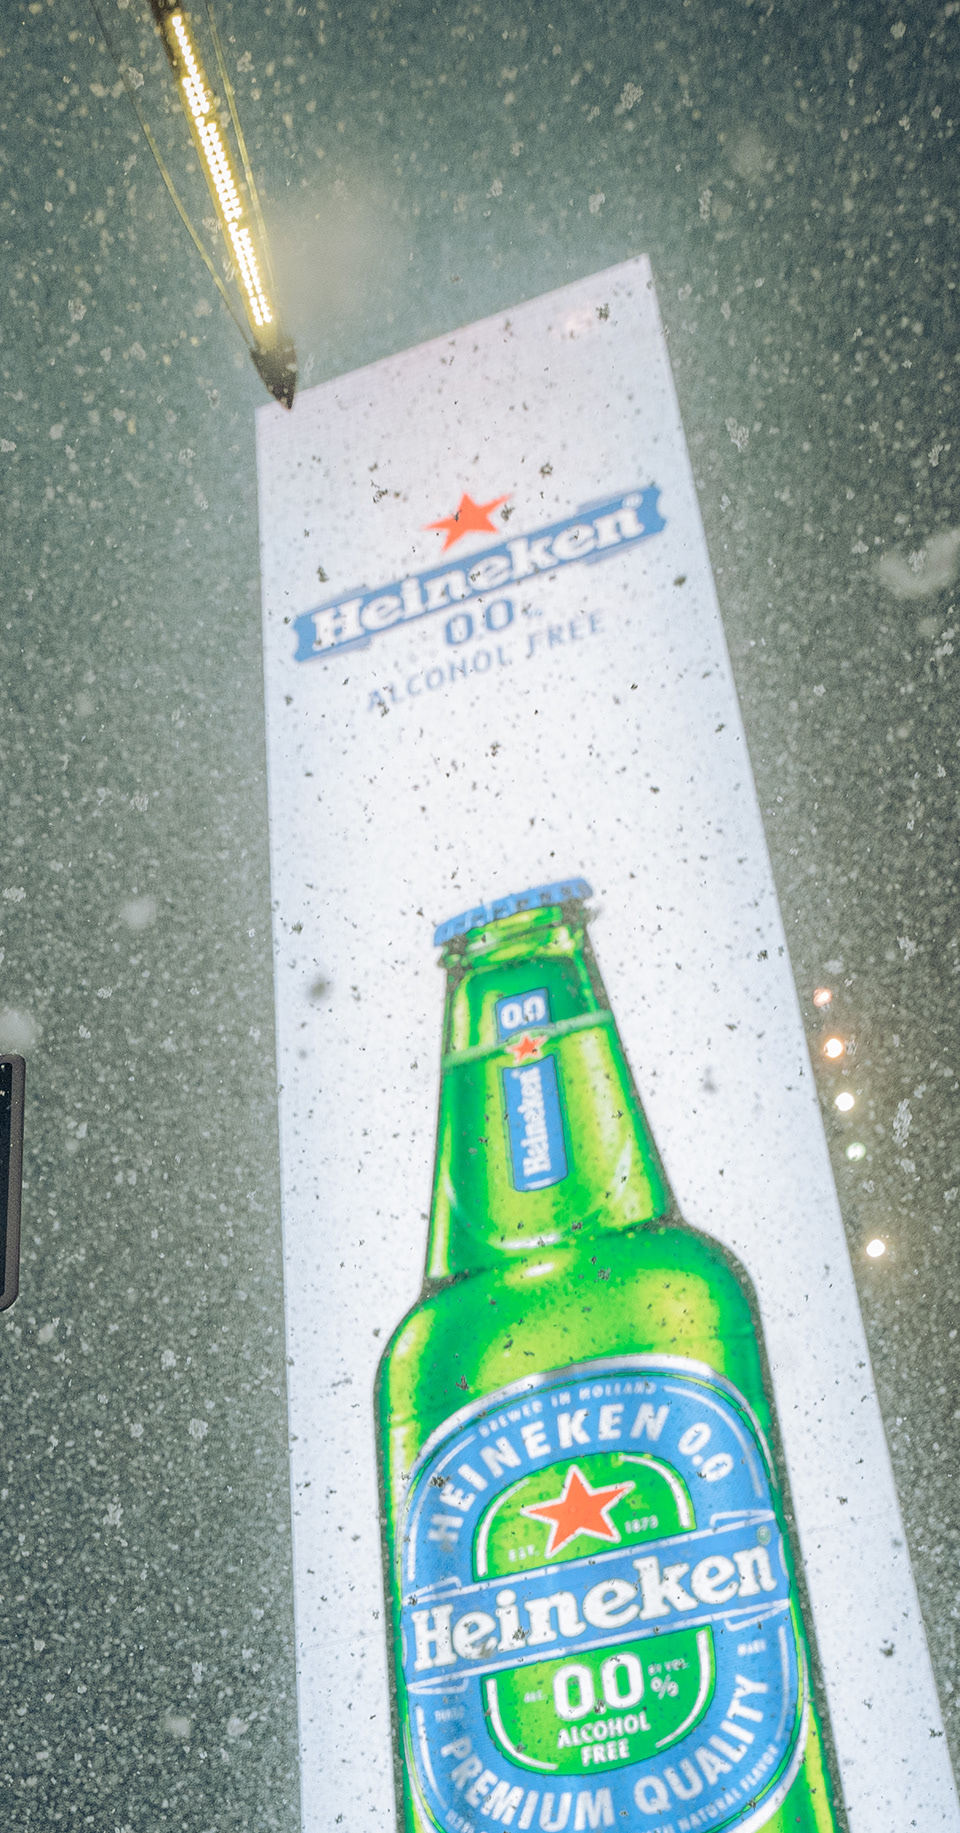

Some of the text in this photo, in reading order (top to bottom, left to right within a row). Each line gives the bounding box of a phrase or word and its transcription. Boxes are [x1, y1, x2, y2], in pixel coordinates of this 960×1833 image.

[312, 506, 645, 651] Heineken
[367, 608, 606, 712] ALCOHOL FREE
[516, 1066, 552, 1177] Heineken
[427, 1402, 735, 1544] HEINEKEN 0.0
[409, 1542, 778, 1672] Heineken
[440, 1673, 770, 1833] PREMIUM QUALITY
[556, 1711, 651, 1750] ALCOHOL
[580, 1737, 631, 1767] FREE
